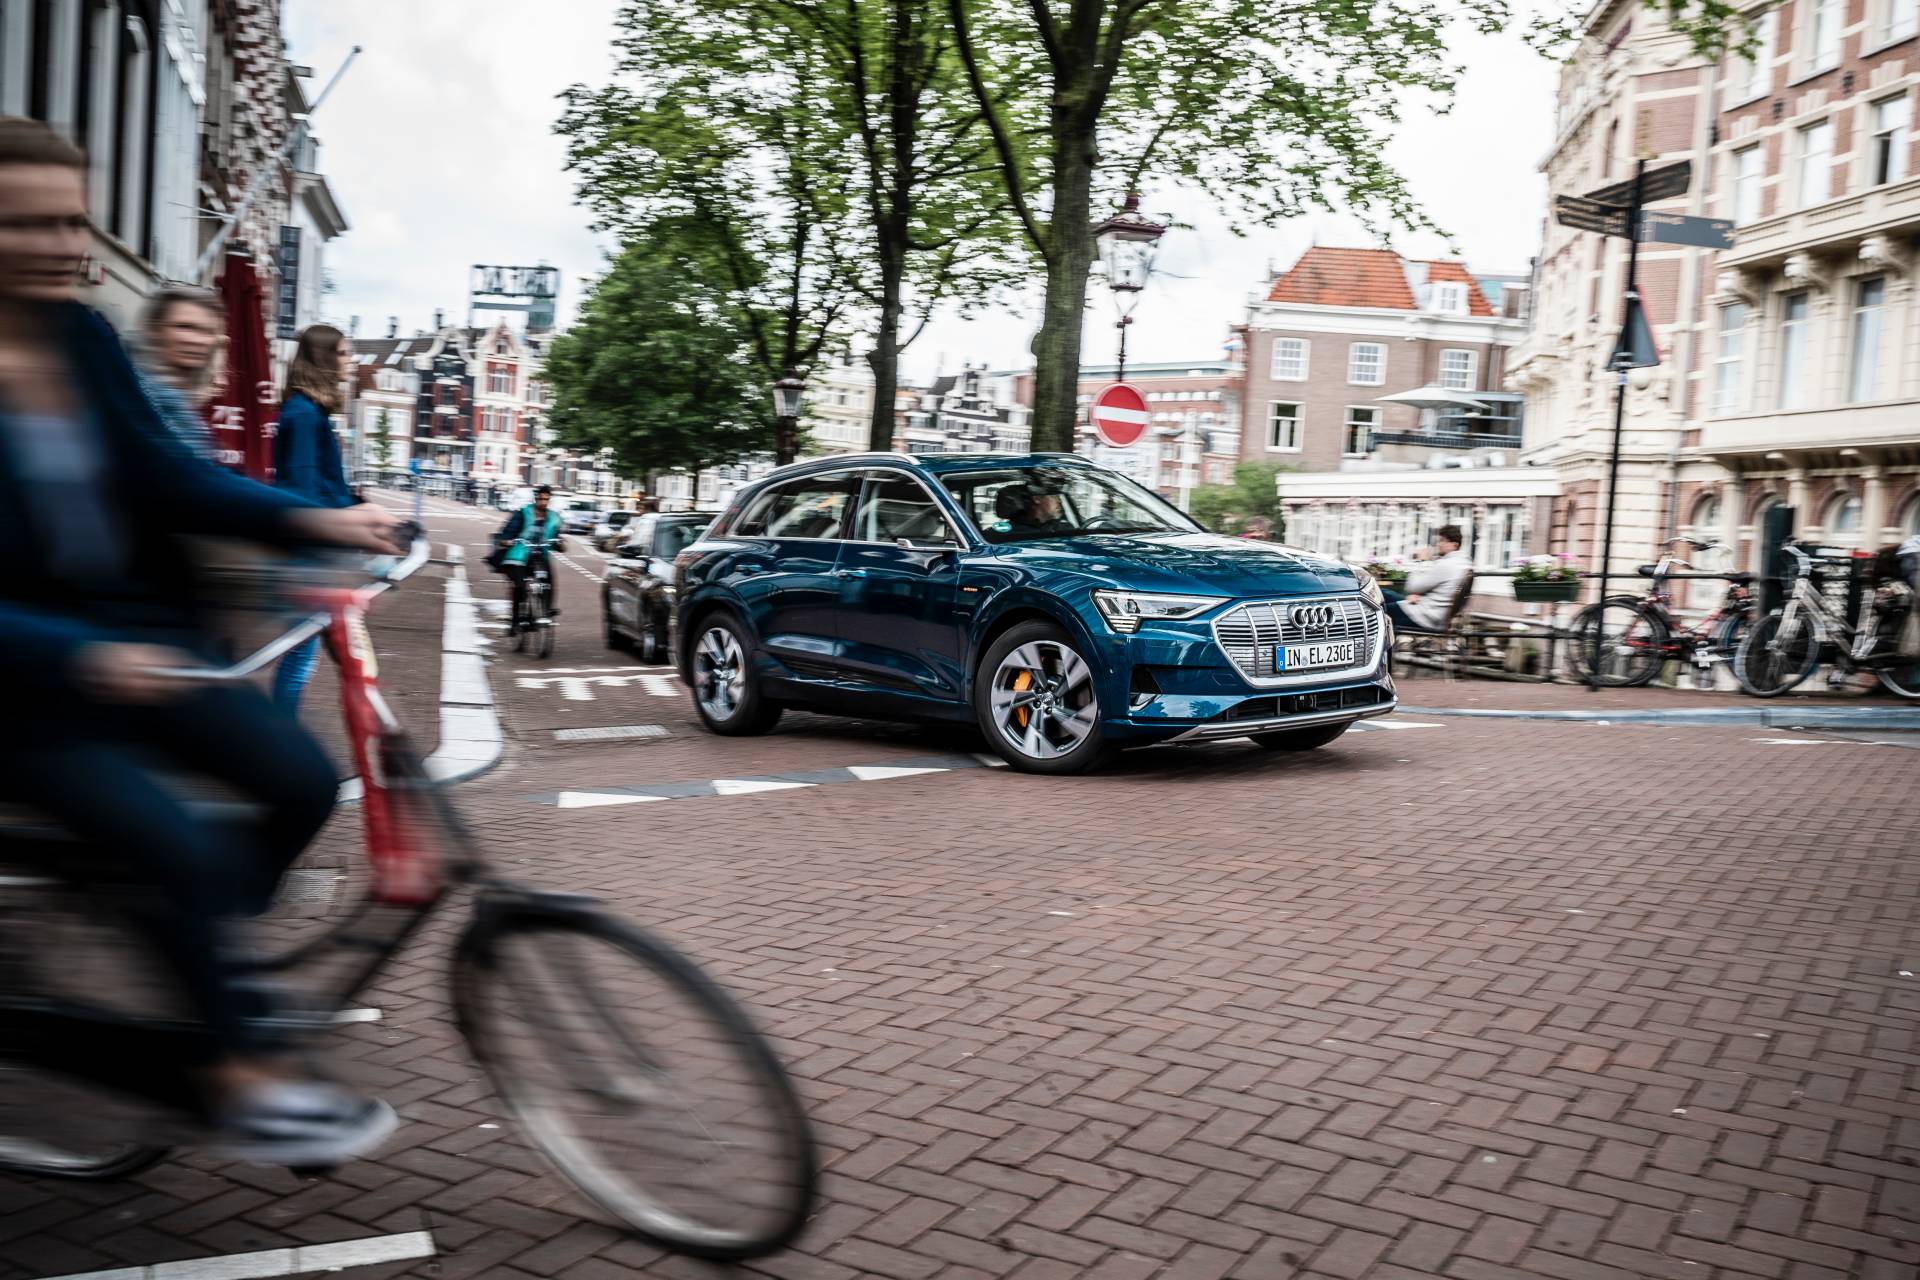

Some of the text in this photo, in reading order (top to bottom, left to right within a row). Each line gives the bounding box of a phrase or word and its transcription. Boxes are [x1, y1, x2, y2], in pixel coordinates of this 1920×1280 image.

[1287, 644, 1353, 666] IN EL 230E
